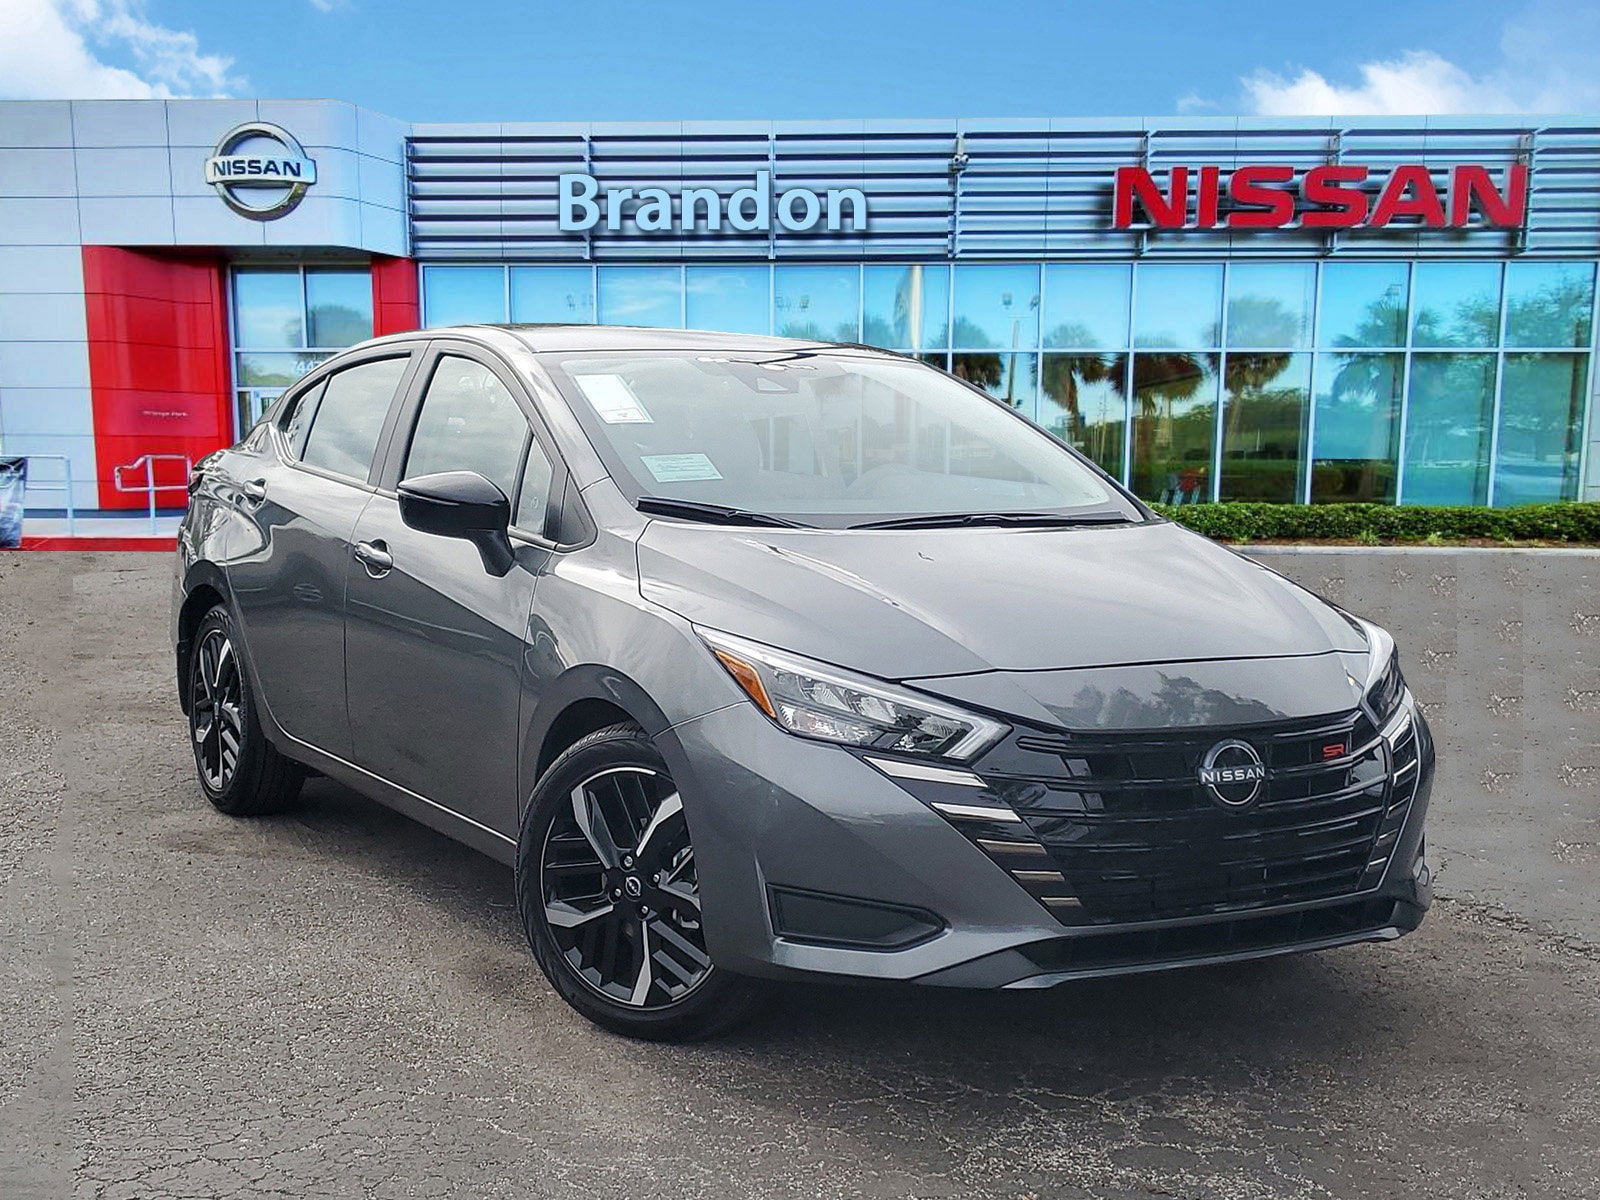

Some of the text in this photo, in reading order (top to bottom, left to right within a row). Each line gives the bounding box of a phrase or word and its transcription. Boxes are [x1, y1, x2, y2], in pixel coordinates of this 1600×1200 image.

[212, 159, 302, 178] NISSAN
[1112, 164, 1529, 229] NISSAN
[1201, 767, 1265, 783] NISSAN
